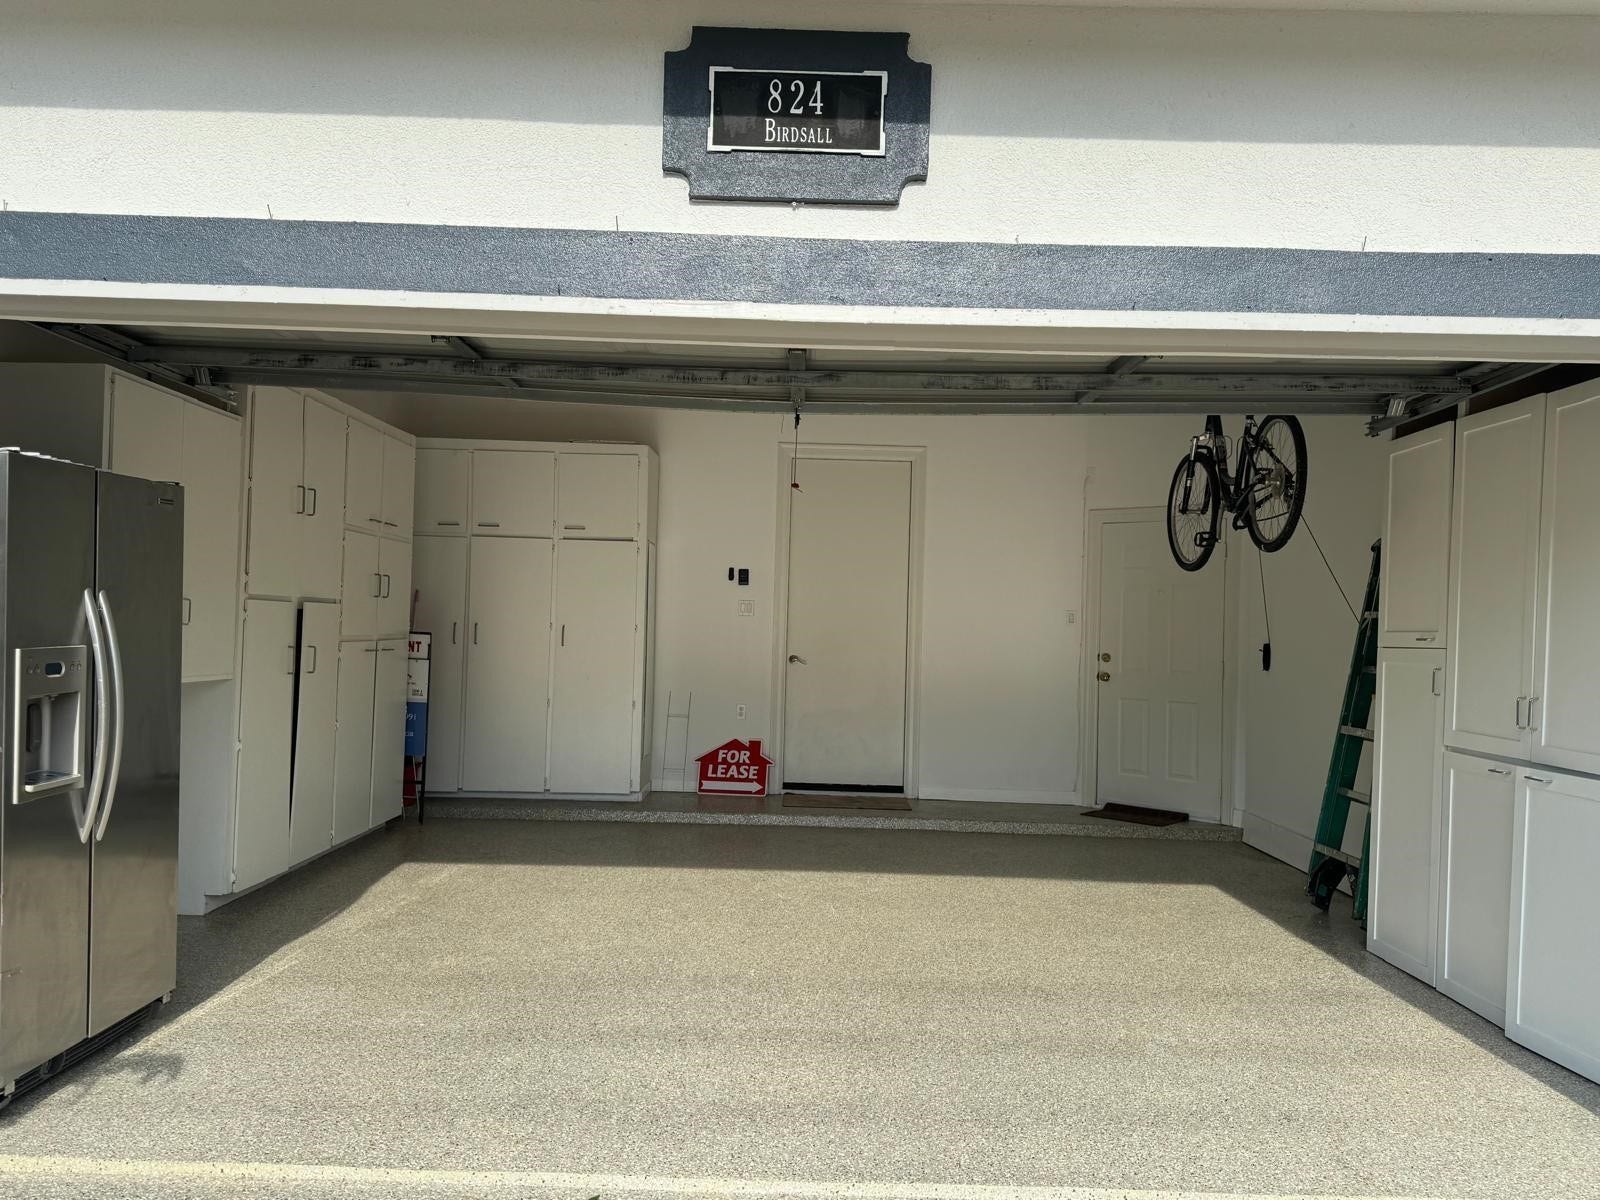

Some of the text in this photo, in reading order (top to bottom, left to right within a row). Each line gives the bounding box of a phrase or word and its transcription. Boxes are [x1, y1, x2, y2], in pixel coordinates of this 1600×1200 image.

[768, 80, 824, 115] 824
[764, 118, 833, 144] BIRDSALL
[718, 750, 751, 764] FOR
[707, 764, 759, 779] LEASE
